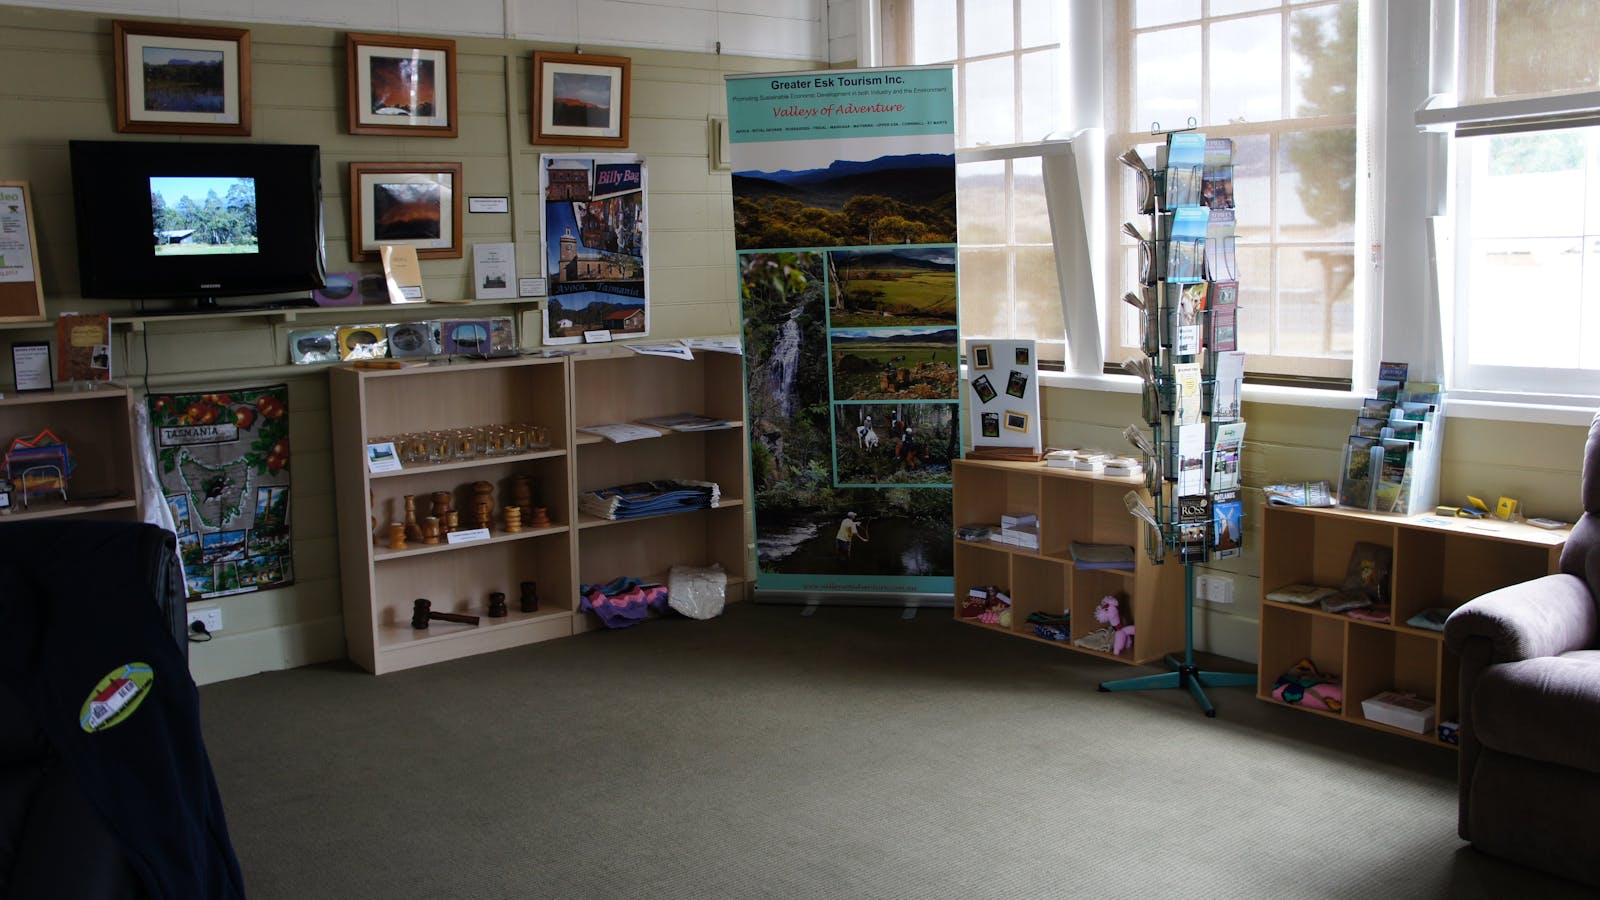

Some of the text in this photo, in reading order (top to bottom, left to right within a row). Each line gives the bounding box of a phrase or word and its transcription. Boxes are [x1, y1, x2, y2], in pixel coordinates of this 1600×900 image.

[771, 75, 905, 90] Greater Esk Tourism Inc.
[773, 102, 905, 119] Valleys of Adventure
[598, 169, 640, 186] Billy Bag
[595, 282, 641, 297] Tasmania
[165, 427, 218, 439] TASMANIA
[1181, 505, 1205, 516] ROSS
